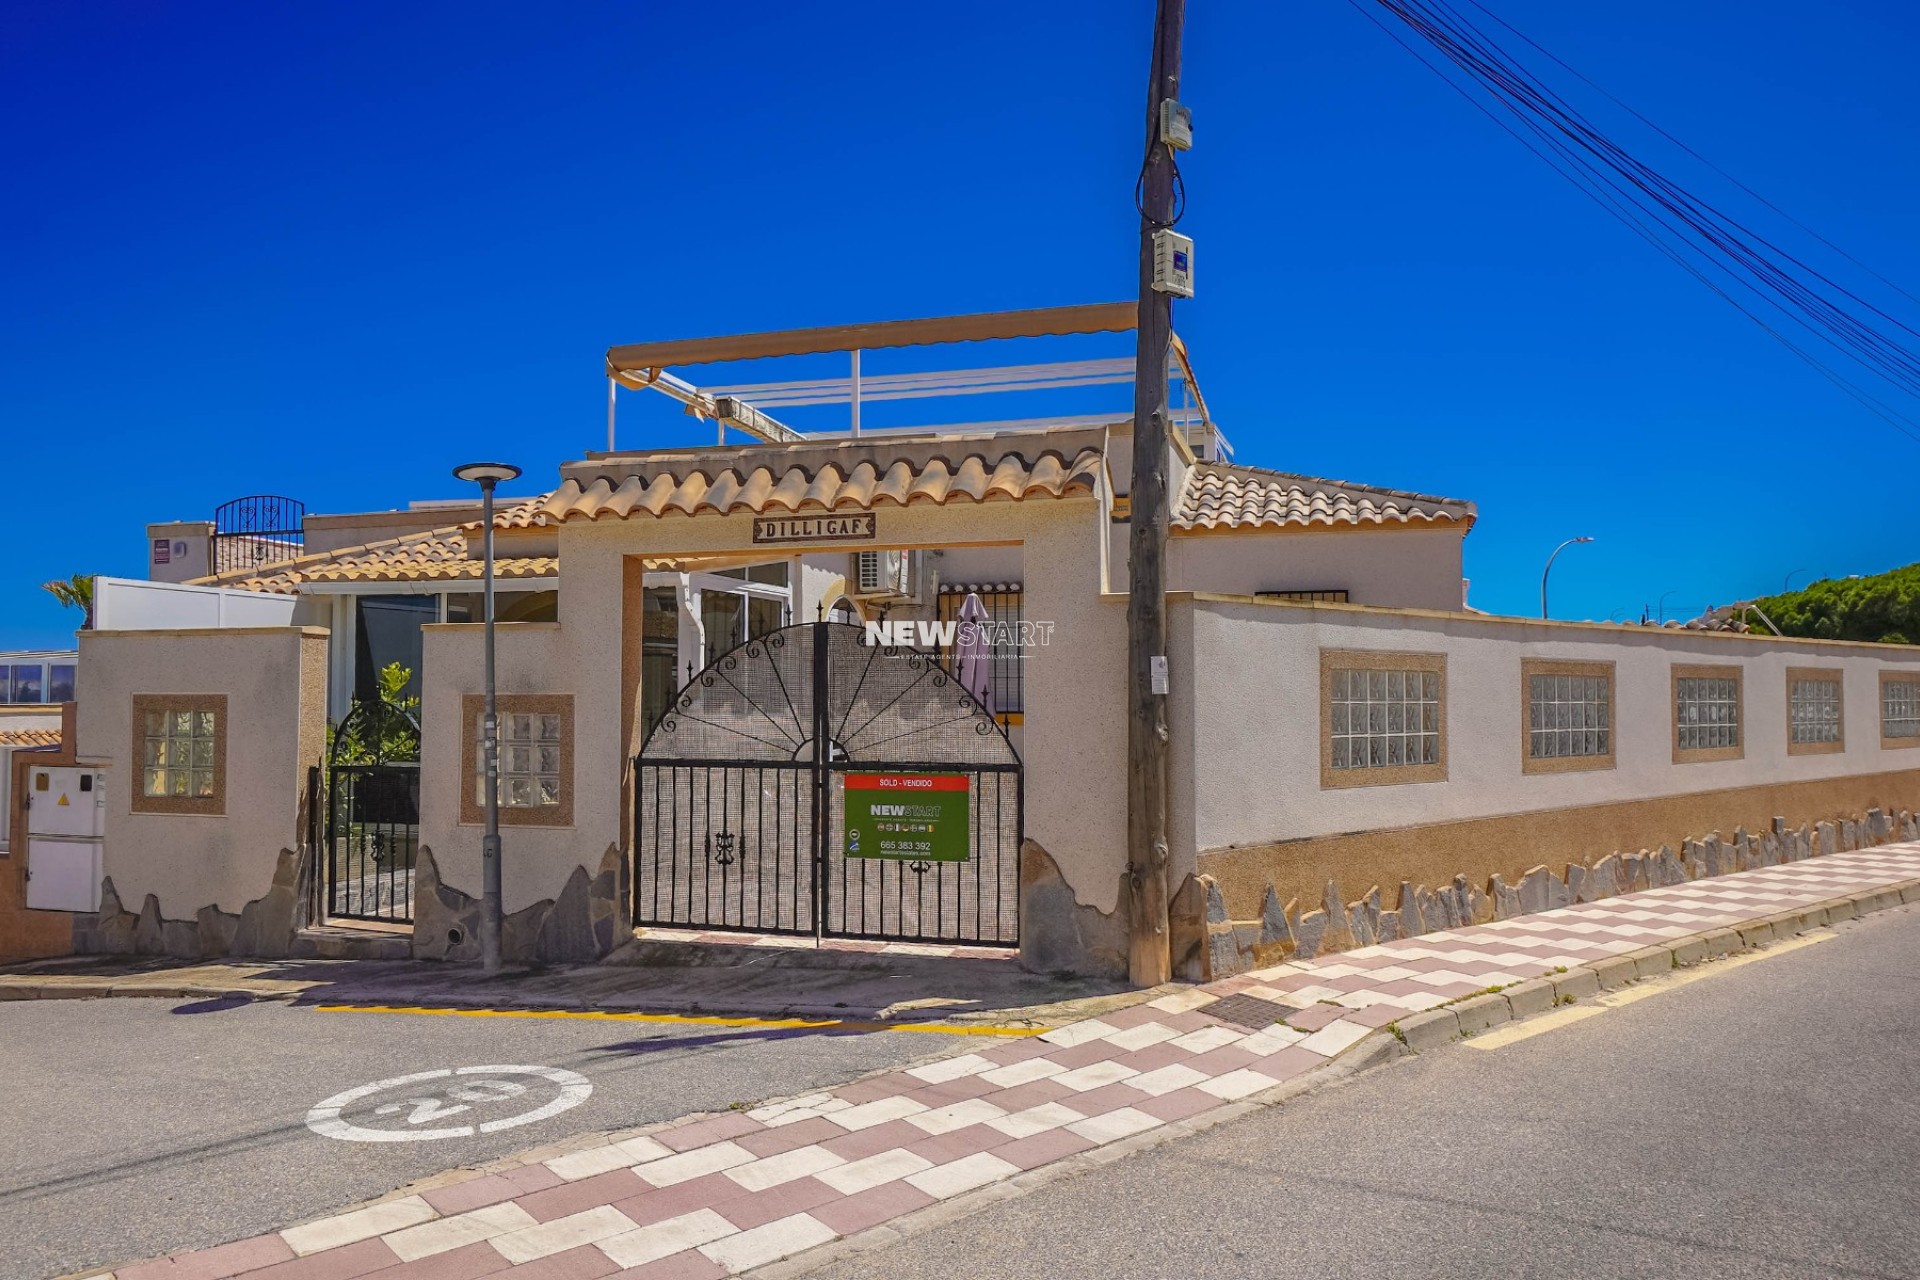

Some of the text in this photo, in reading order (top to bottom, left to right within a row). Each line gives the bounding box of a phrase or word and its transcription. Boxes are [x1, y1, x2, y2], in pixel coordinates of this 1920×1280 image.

[766, 519, 862, 537] DILLIGAF
[879, 778, 898, 787] SOLD
[902, 779, 933, 787] VENDIDO
[880, 840, 931, 851] 665 383 392
[374, 1079, 527, 1124] 20
